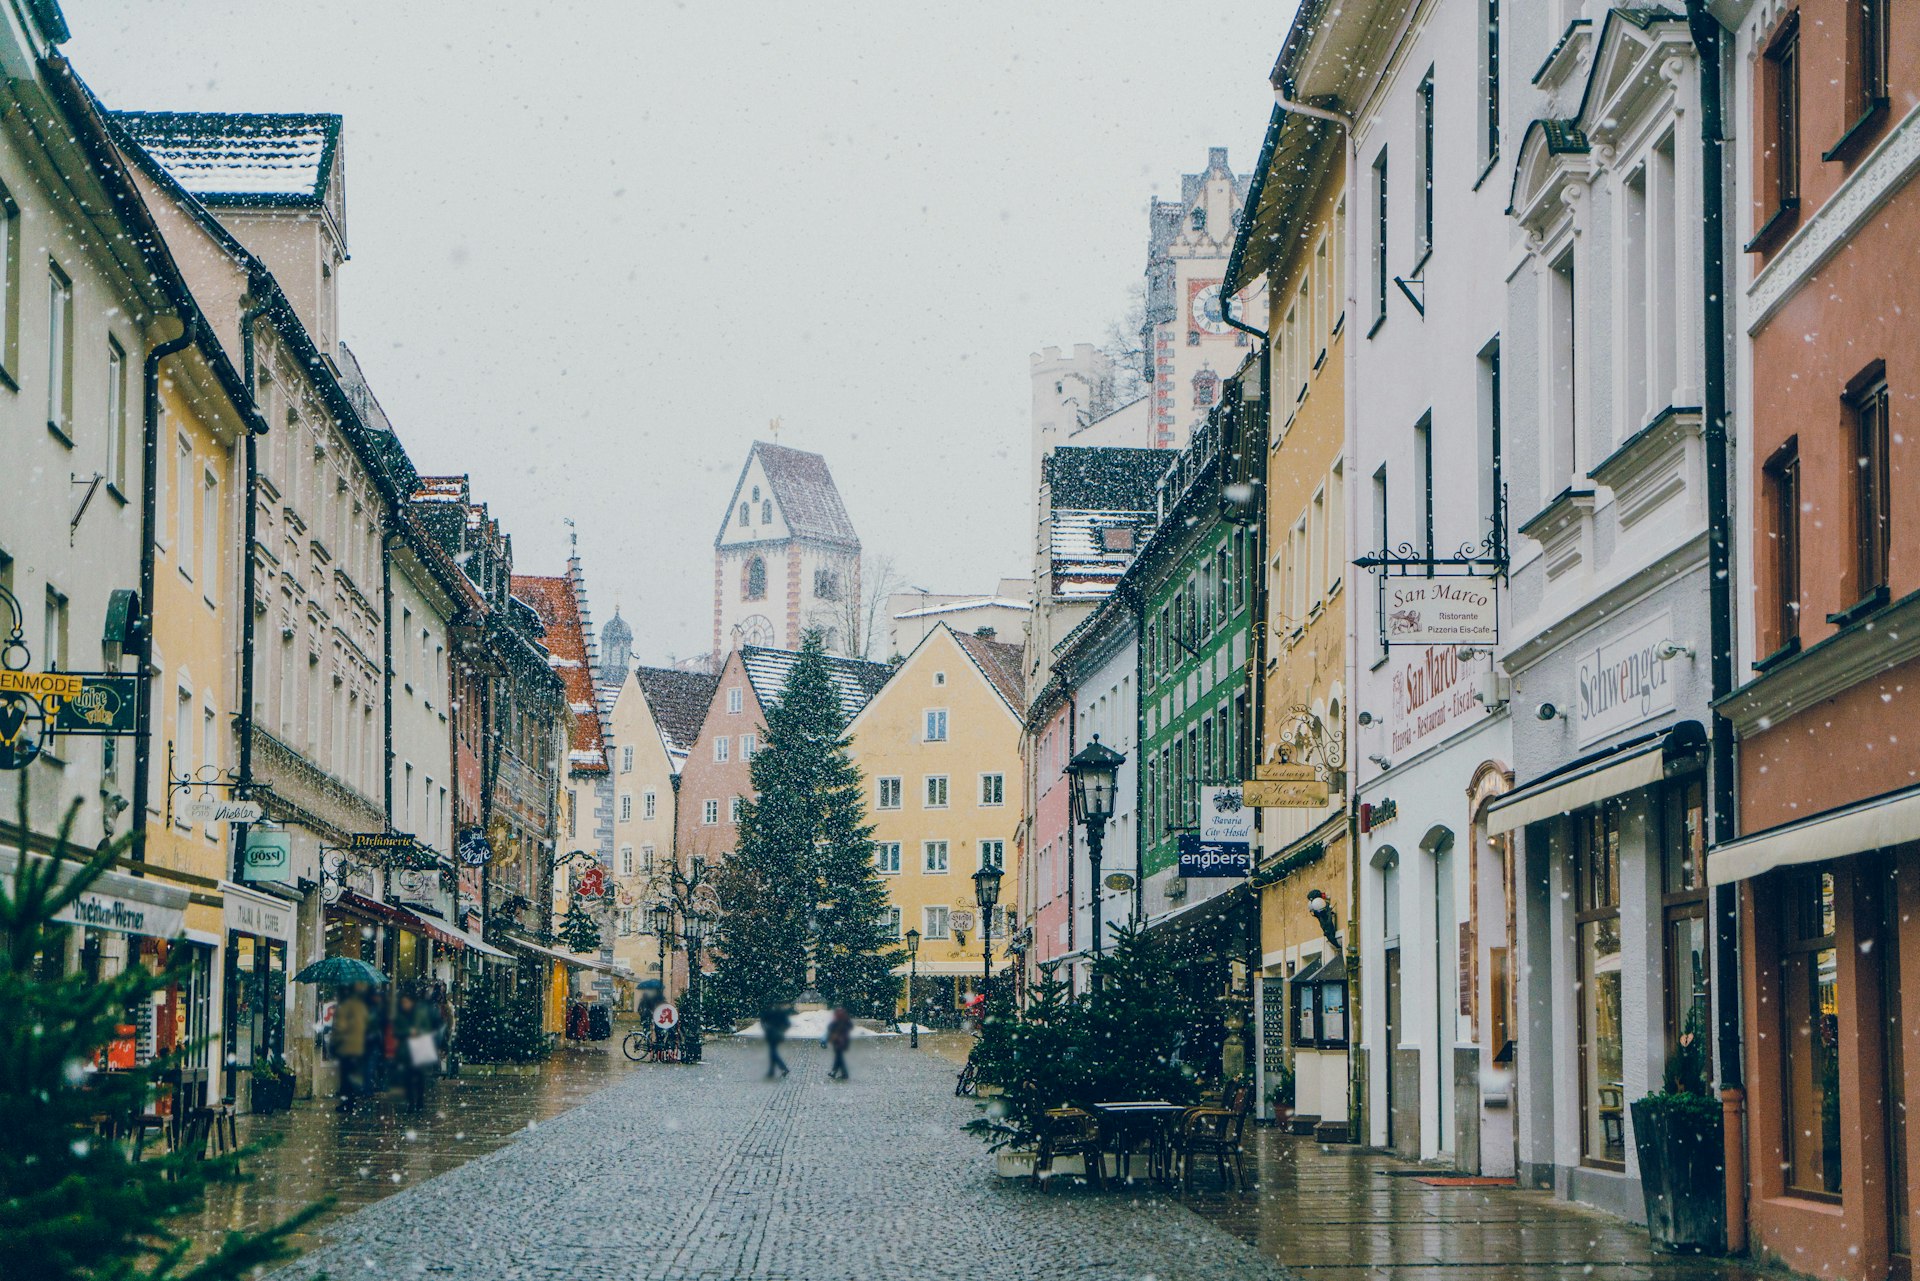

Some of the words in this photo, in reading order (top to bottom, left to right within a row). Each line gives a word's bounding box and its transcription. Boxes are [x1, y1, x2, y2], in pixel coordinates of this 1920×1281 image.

[1394, 589, 1425, 608] San
[1431, 584, 1488, 607] Marco
[1439, 612, 1479, 620] Ristorante
[1427, 625, 1458, 634] Pizzeria
[1406, 663, 1425, 715] San
[1425, 644, 1458, 702] Marco
[85, 703, 114, 726] vita
[1417, 700, 1447, 740] Restaurant
[1262, 766, 1311, 778] Ludwigs
[1263, 782, 1309, 795] Hotel
[1247, 794, 1325, 807] Restaurant
[191, 810, 210, 818] FOTO
[1211, 815, 1242, 826] Bavaria
[1205, 827, 1221, 841] City
[1223, 825, 1251, 837] Hostel
[356, 834, 412, 847] Parfümerie
[250, 850, 280, 864] gössl
[1181, 851, 1247, 869] engbers
